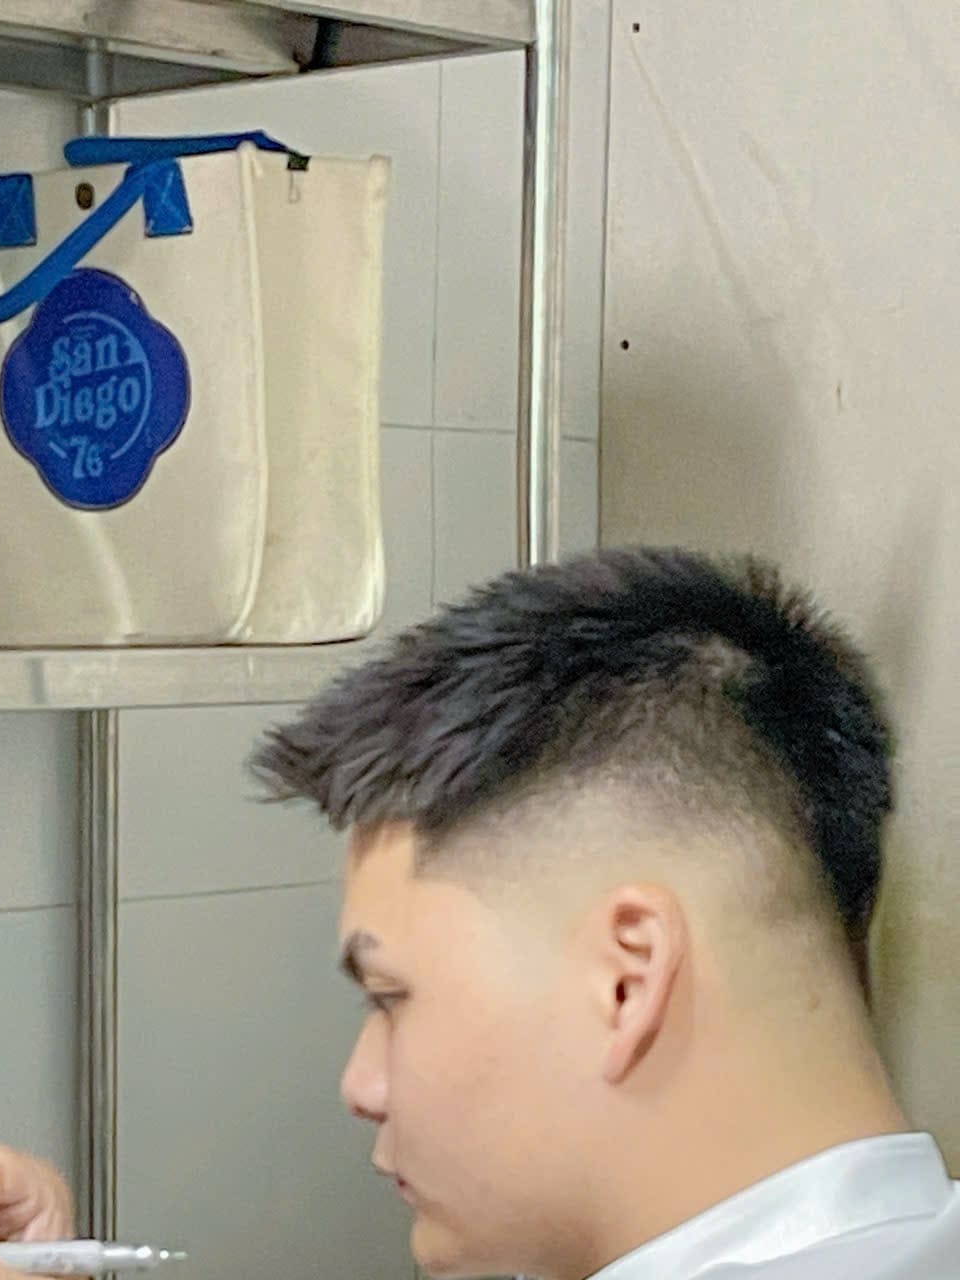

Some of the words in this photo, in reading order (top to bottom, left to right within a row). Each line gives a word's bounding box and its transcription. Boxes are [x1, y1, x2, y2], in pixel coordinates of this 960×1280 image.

[48, 333, 126, 387] San
[33, 376, 141, 430] Diego
[69, 435, 104, 479] 76
